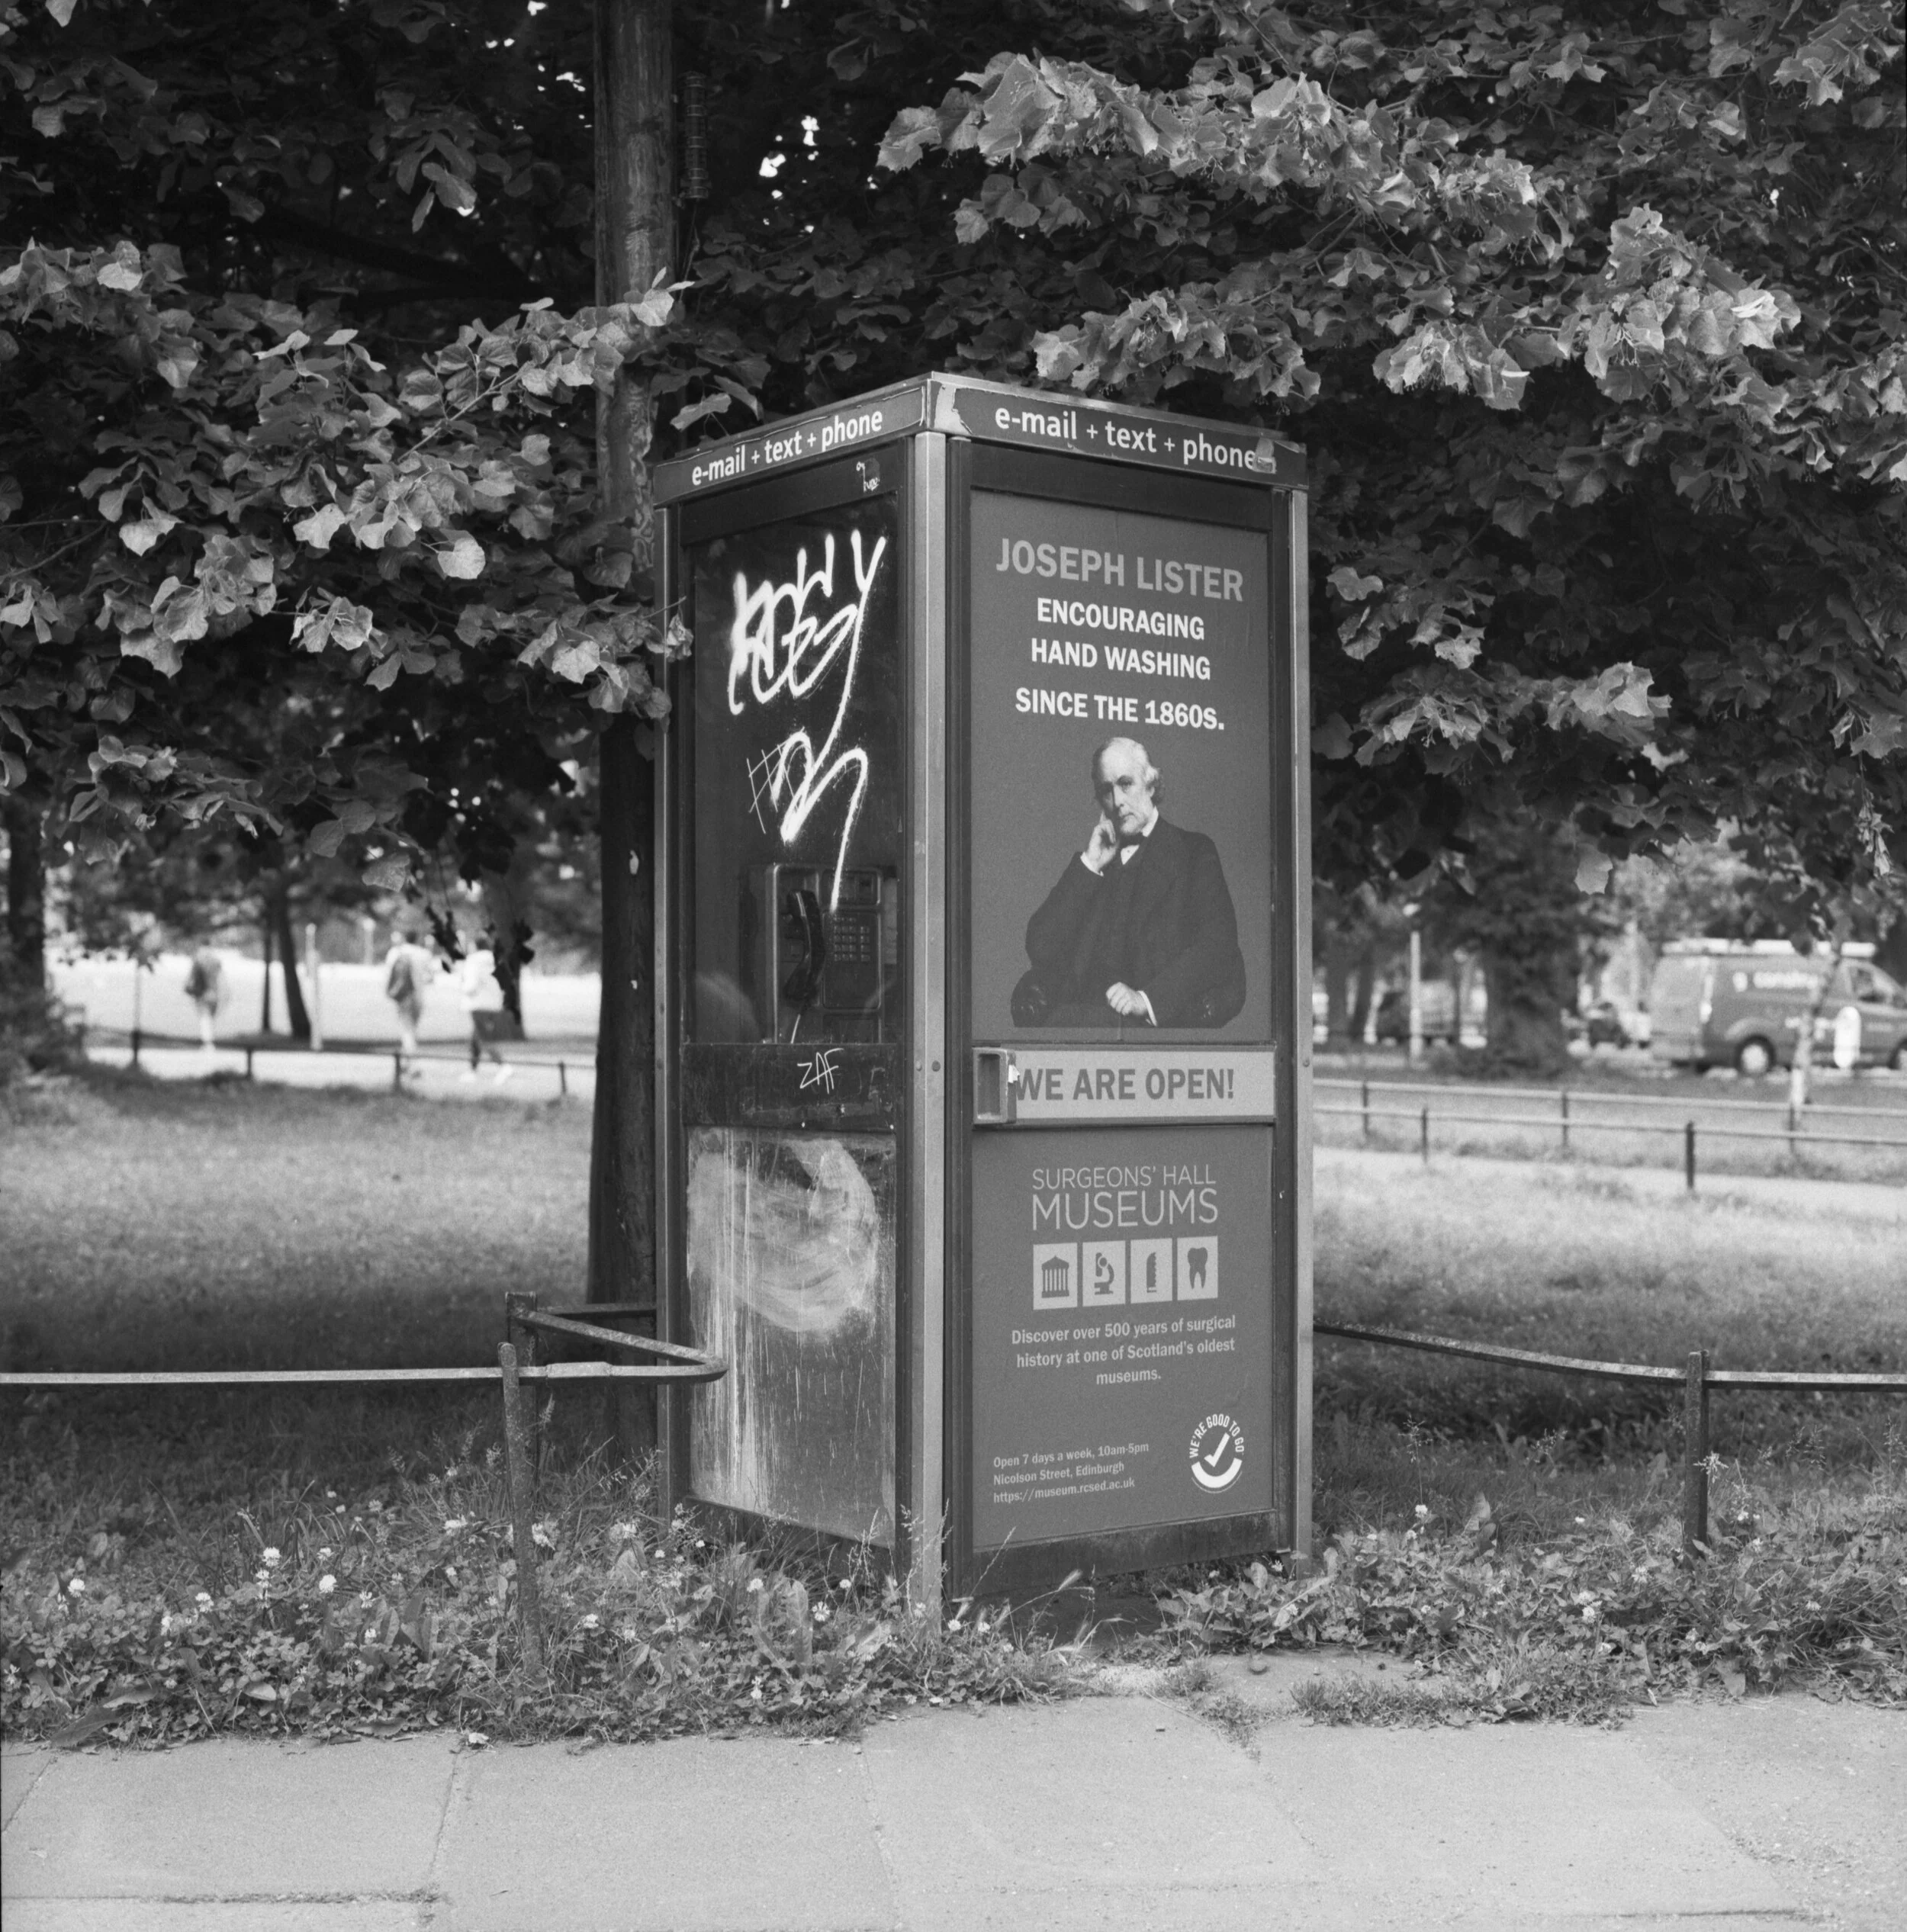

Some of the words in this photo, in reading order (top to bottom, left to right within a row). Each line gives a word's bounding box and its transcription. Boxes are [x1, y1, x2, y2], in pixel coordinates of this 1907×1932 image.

[692, 445, 745, 486] e-mail
[764, 431, 802, 464] text
[822, 410, 883, 452] phone
[995, 407, 1077, 440] e-mail
[1105, 420, 1156, 453] text
[1183, 432, 1256, 471] phone
[996, 538, 1124, 587] JOSEPH
[1137, 557, 1243, 602] LISTER
[1037, 597, 1204, 641] ENCOURAGING
[1031, 638, 1098, 667] HAND
[1104, 645, 1211, 680] WASHING
[1015, 687, 1088, 718] SINCE
[1094, 695, 1138, 722] THE
[1015, 1068, 1063, 1101] WE
[1072, 1069, 1136, 1100] ARE
[1145, 1069, 1235, 1100] OPEN!
[1032, 1166, 1156, 1190] SURGEONS'
[1163, 1164, 1216, 1185] HALL
[1032, 1188, 1218, 1230] MUSEUMS
[1011, 1329, 1069, 1345] Discover
[1073, 1326, 1101, 1340] over
[1105, 1323, 1130, 1337] 500
[1134, 1323, 1168, 1339] years
[1171, 1318, 1184, 1332] of
[1186, 1315, 1236, 1334] surgical
[1017, 1352, 1063, 1368] history
[1066, 1349, 1080, 1364] at
[1083, 1349, 1108, 1363] one
[1111, 1345, 1124, 1360] of
[1127, 1340, 1194, 1358] Scotland's
[1197, 1337, 1235, 1353] oldest
[1096, 1371, 1162, 1385] museums.
[1206, 1413, 1230, 1429] GOOD
[1229, 1420, 1240, 1437] TO
[1189, 1422, 1208, 1458] WE'RE
[1234, 1437, 1245, 1453] GO
[993, 1457, 1020, 1469] Open
[1022, 1454, 1030, 1464] 7
[1032, 1452, 1055, 1465] days
[1057, 1452, 1063, 1461] a
[1066, 1448, 1095, 1461] week,
[993, 1472, 1037, 1486] Nicolson
[1040, 1467, 1074, 1481] Street,
[1076, 1461, 1125, 1477] Edinburgh
[993, 1477, 1136, 1504] https://museum.rcsed.ac.uk
